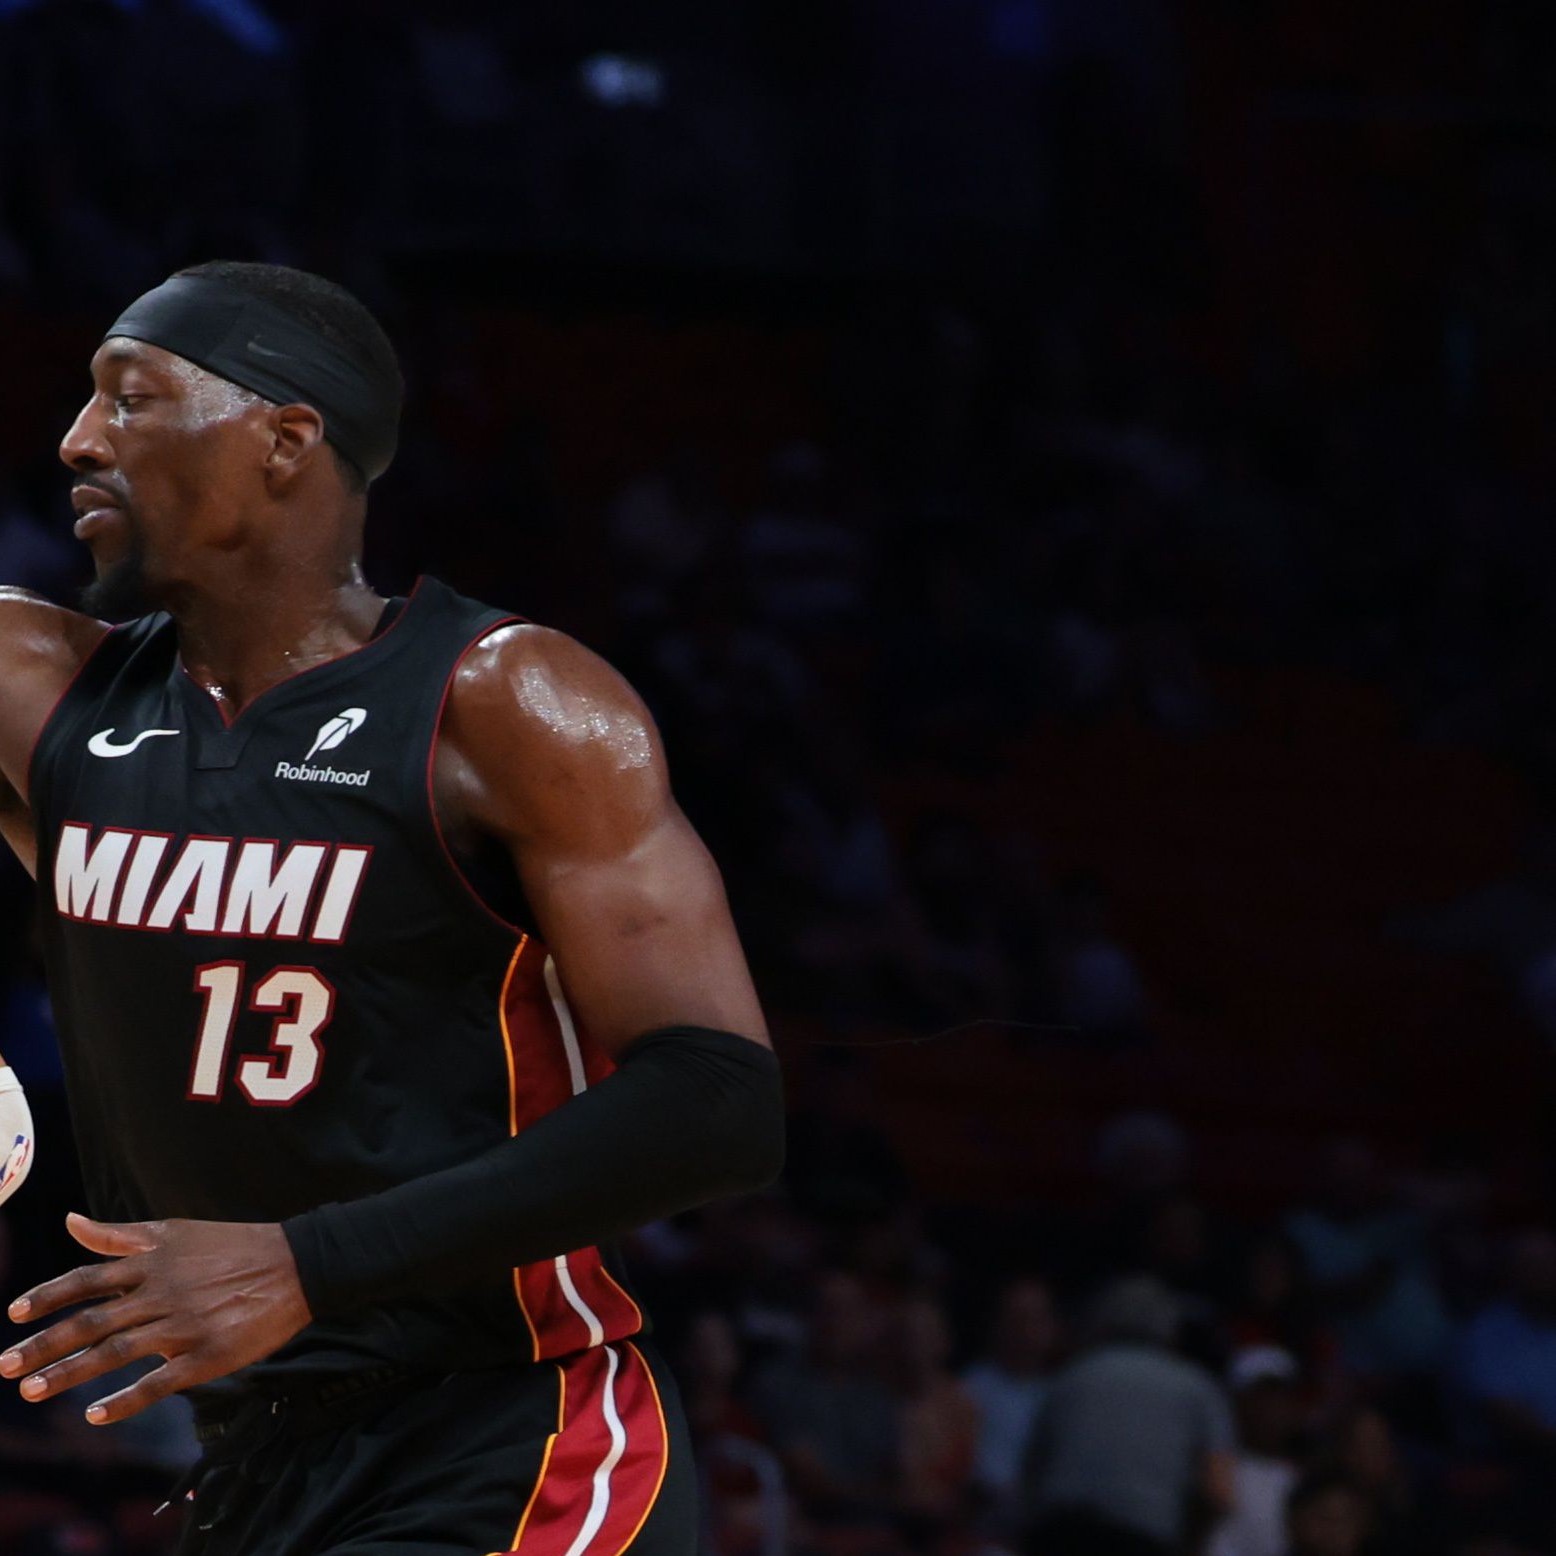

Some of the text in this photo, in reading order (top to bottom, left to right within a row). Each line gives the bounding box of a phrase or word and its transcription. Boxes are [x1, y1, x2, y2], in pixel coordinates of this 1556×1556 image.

[274, 761, 371, 788] Robinhood
[53, 819, 375, 945] MIAMI
[186, 959, 336, 1108] 13
